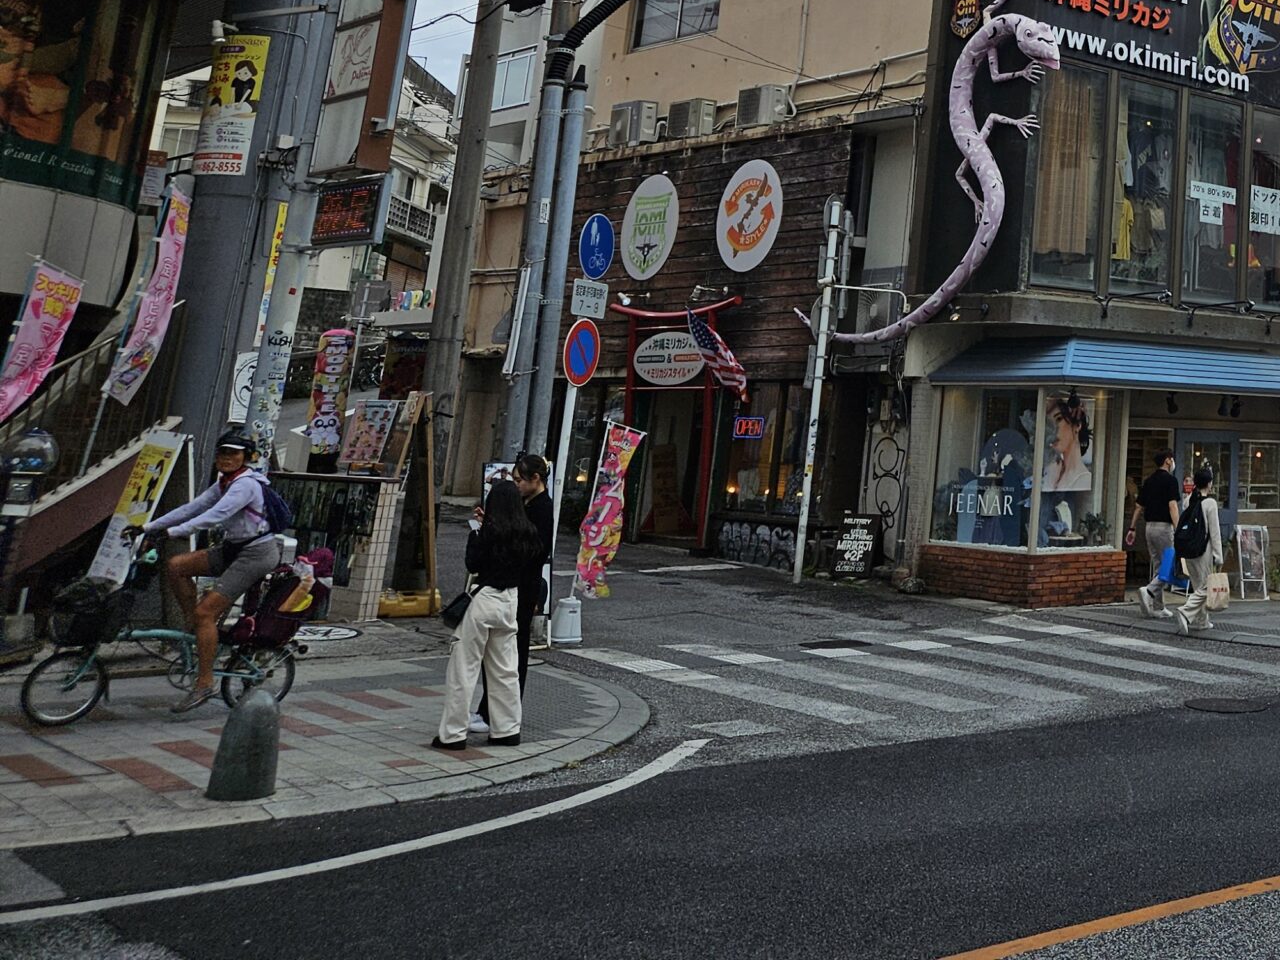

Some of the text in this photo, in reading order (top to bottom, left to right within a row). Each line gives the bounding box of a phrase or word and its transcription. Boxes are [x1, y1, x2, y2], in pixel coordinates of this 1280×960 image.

[1049, 24, 1250, 92] www.okimiri.com
[1202, 204, 1221, 219] 古着
[744, 226, 766, 244] STYLE
[652, 337, 689, 351] 沖縄ミリカジ
[735, 419, 762, 435] OPEN
[948, 492, 1014, 517] JEENAR
[836, 539, 873, 552] MIRIKAJI
